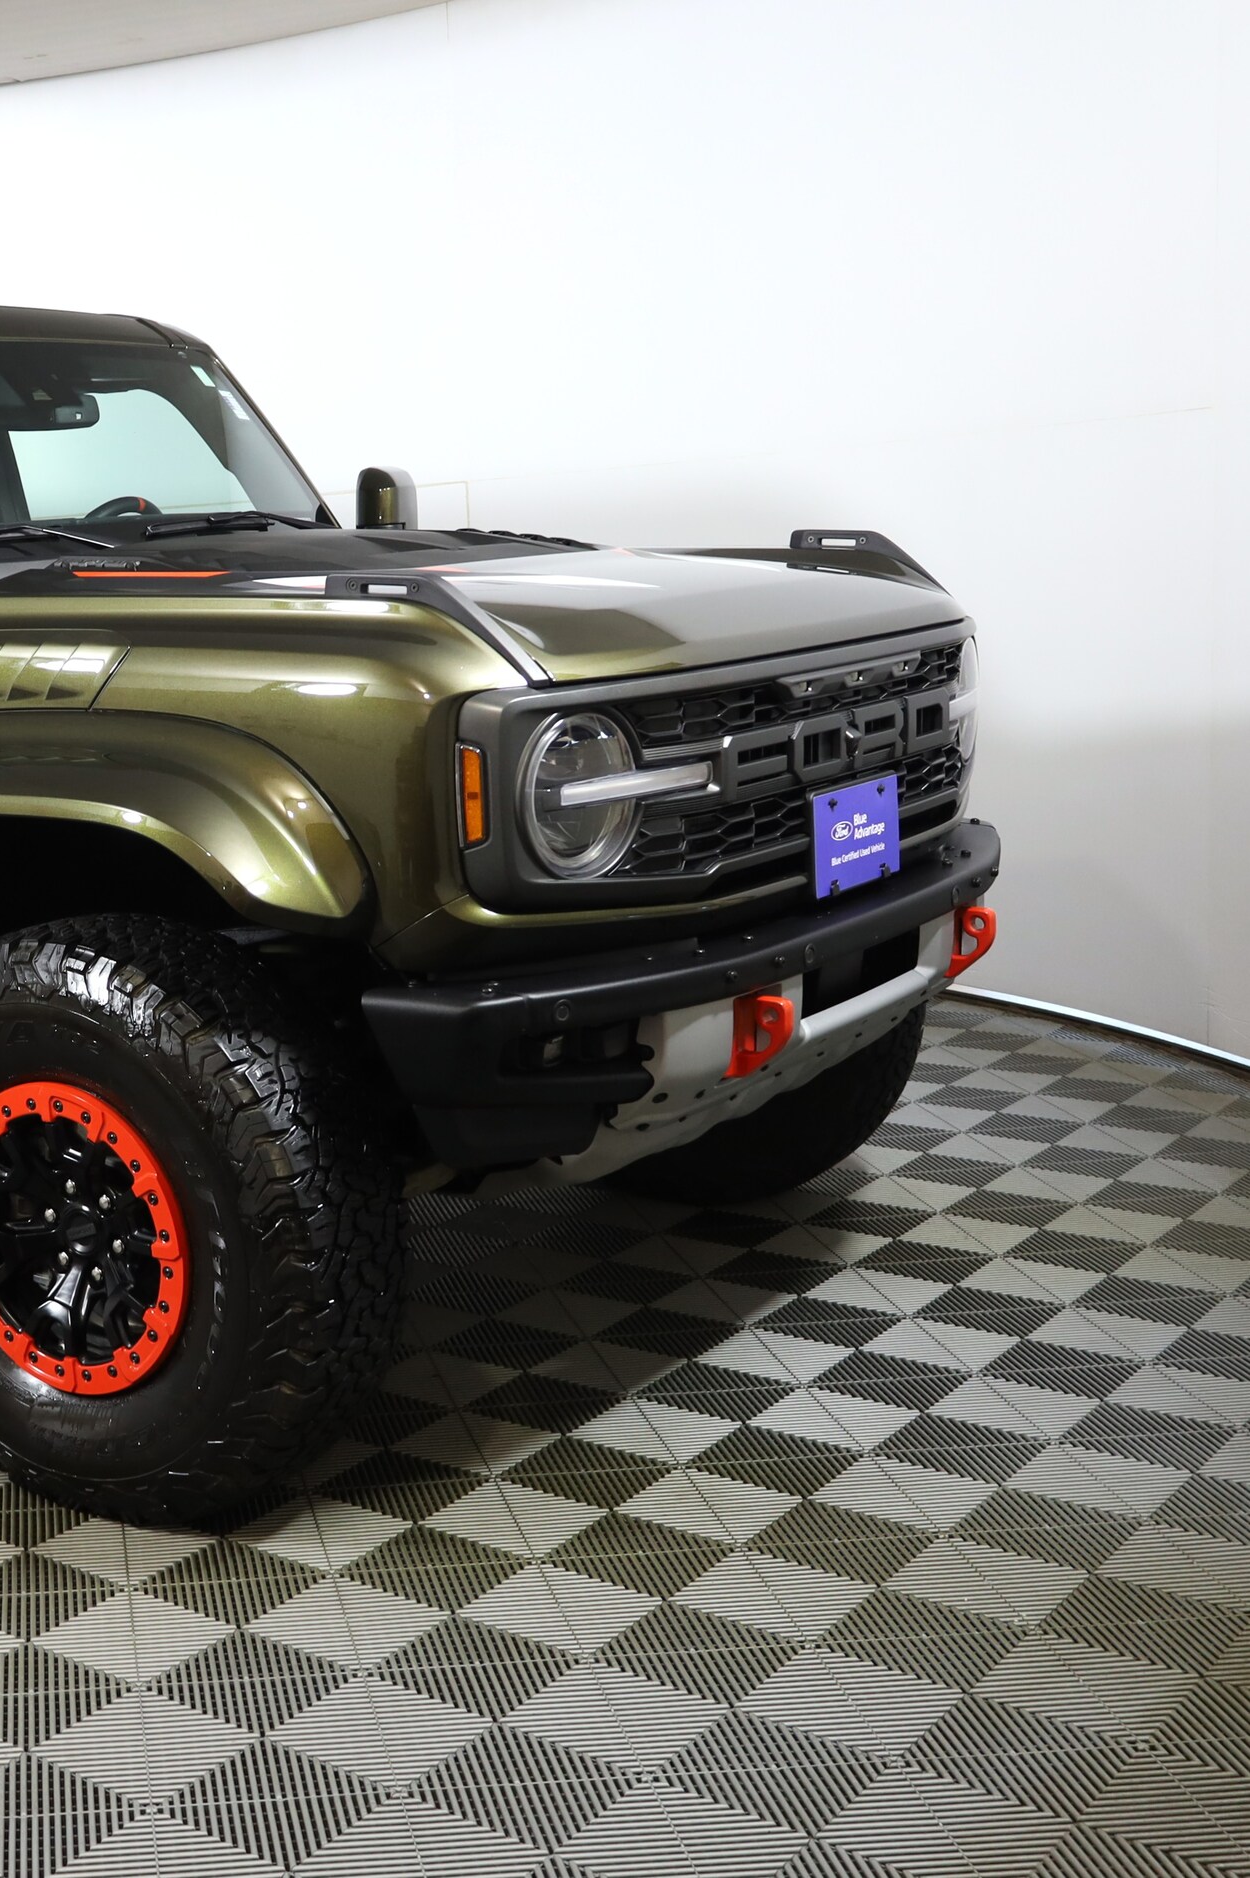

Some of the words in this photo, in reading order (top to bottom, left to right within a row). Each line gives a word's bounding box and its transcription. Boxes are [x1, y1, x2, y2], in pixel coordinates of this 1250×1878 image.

[722, 687, 952, 804] FORD
[853, 813, 867, 826] Blue
[854, 822, 885, 840] Advantage
[831, 857, 842, 866] Blue
[841, 850, 860, 862] Certified
[859, 847, 871, 857] Used
[870, 842, 885, 853] Vehicle
